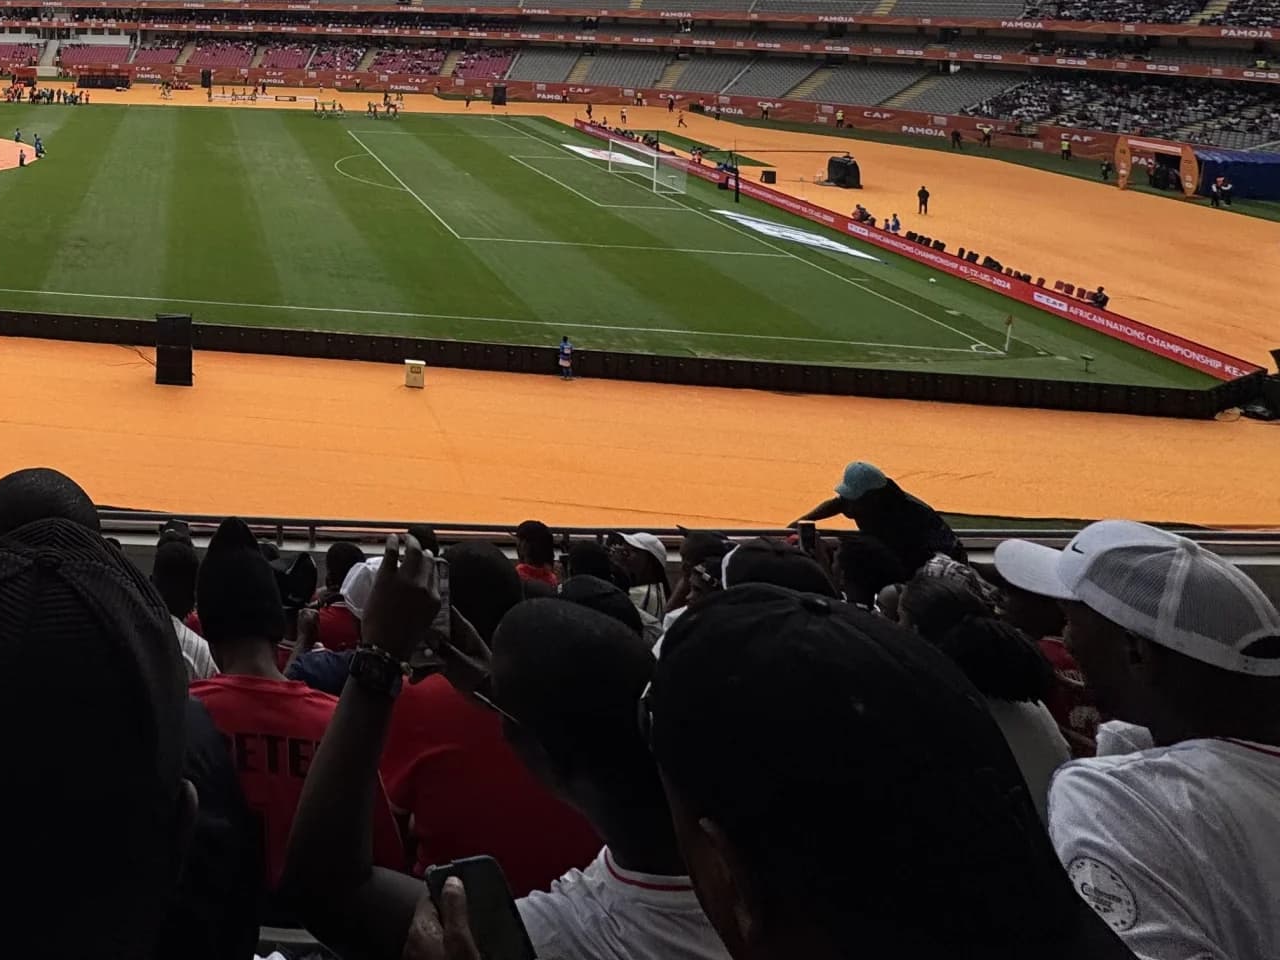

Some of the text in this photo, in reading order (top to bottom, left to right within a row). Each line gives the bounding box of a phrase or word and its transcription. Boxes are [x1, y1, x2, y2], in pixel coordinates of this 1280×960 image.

[1001, 21, 1043, 29] PAMOJA
[1221, 29, 1272, 38] PAMOJA
[863, 111, 893, 119] CAF
[901, 125, 947, 137] PAMOJA
[1060, 133, 1095, 142] CAF
[1069, 306, 1105, 324] AFRICAN
[1105, 319, 1146, 341] NATIONS
[1146, 334, 1222, 369] CHAMPIONSHIP
[226, 732, 318, 778] ETE
